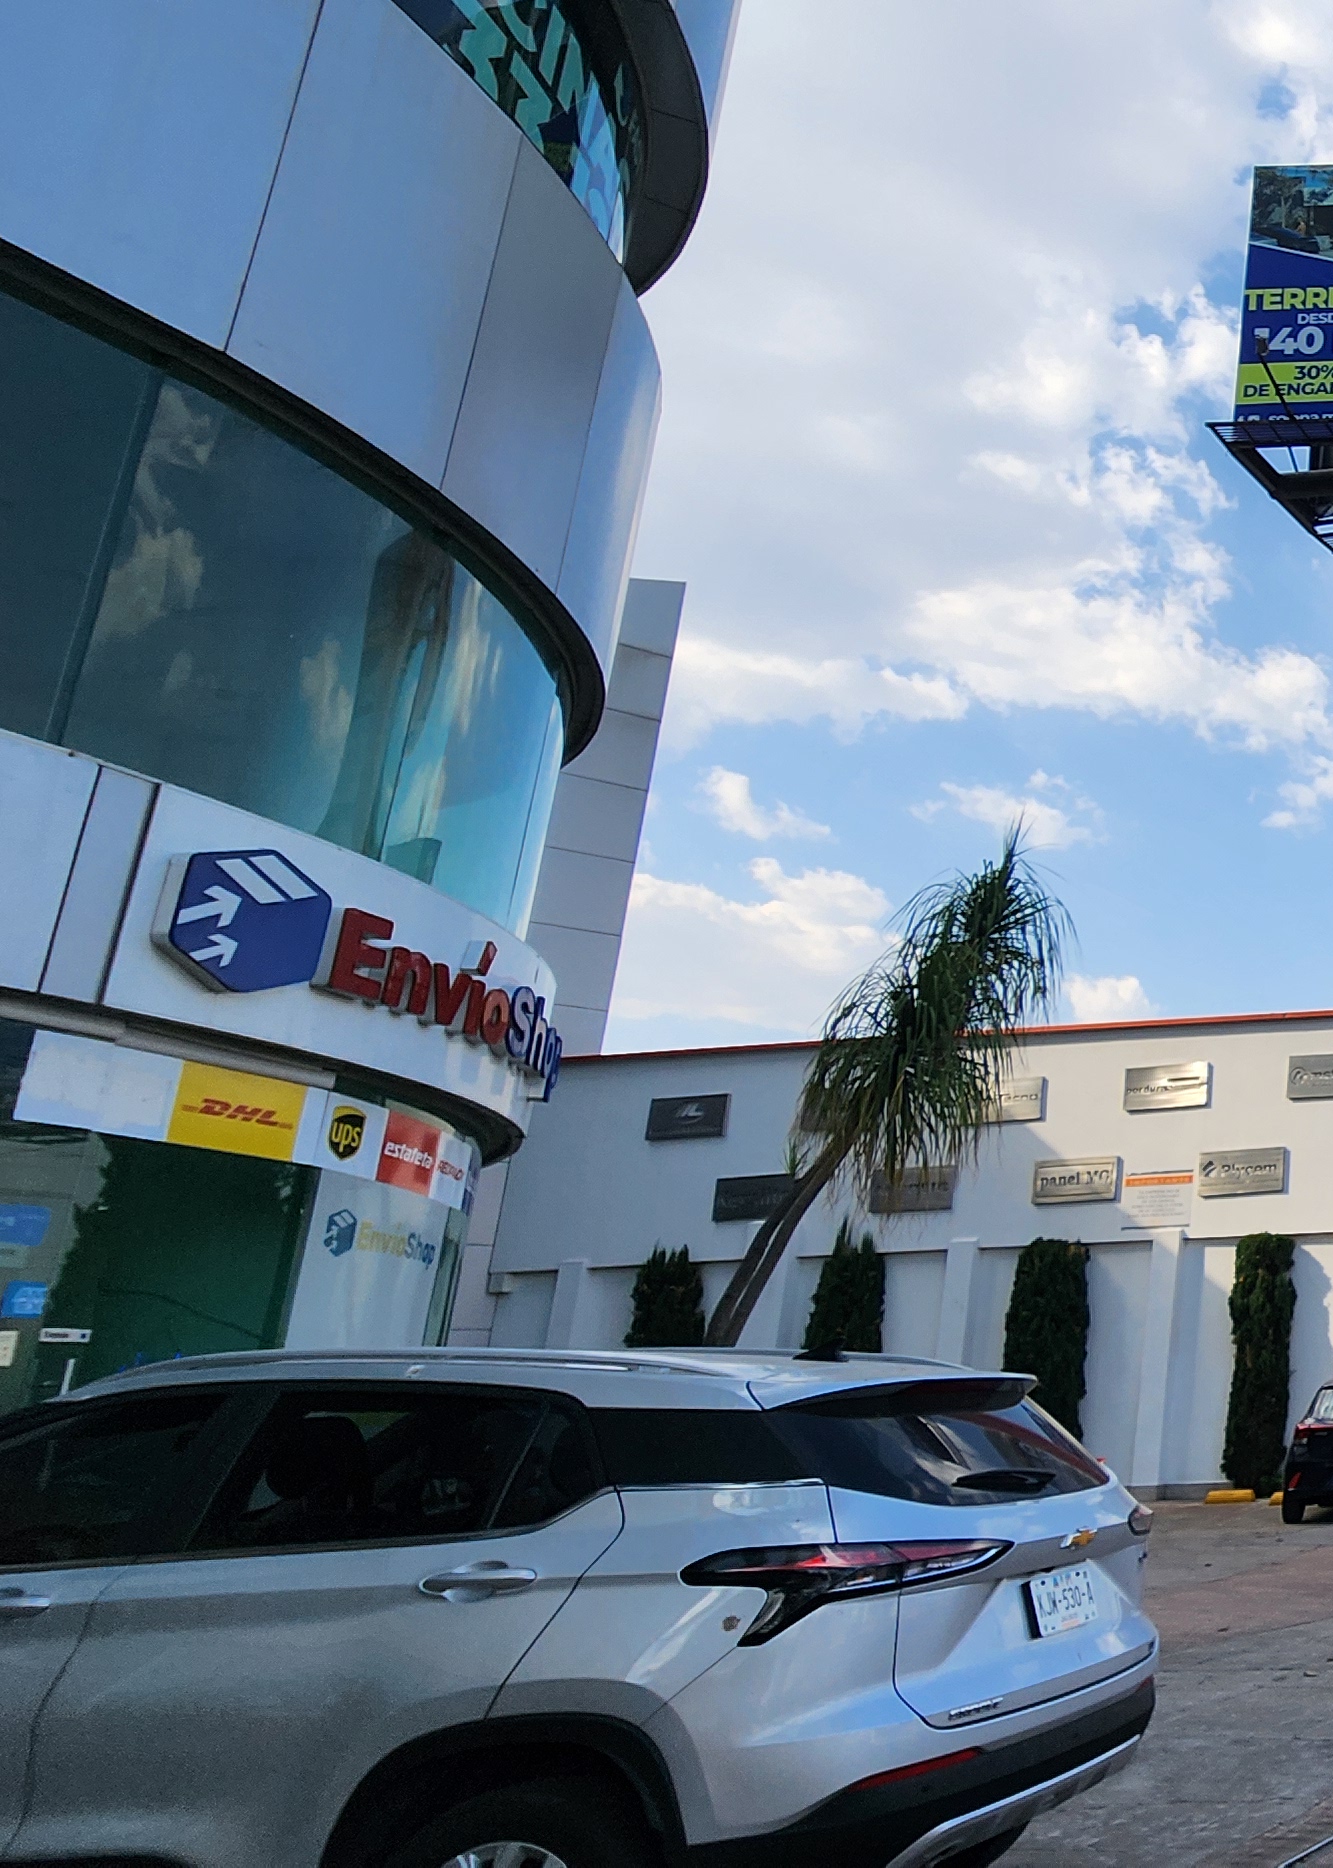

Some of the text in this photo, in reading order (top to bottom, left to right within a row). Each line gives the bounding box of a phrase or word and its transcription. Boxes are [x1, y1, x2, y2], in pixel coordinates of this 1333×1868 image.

[1243, 384, 1270, 398] DE
[200, 1098, 278, 1126] DHL
[332, 1122, 361, 1153] ups
[384, 1141, 433, 1169] estafeta
[1040, 1176, 1080, 1191] panel
